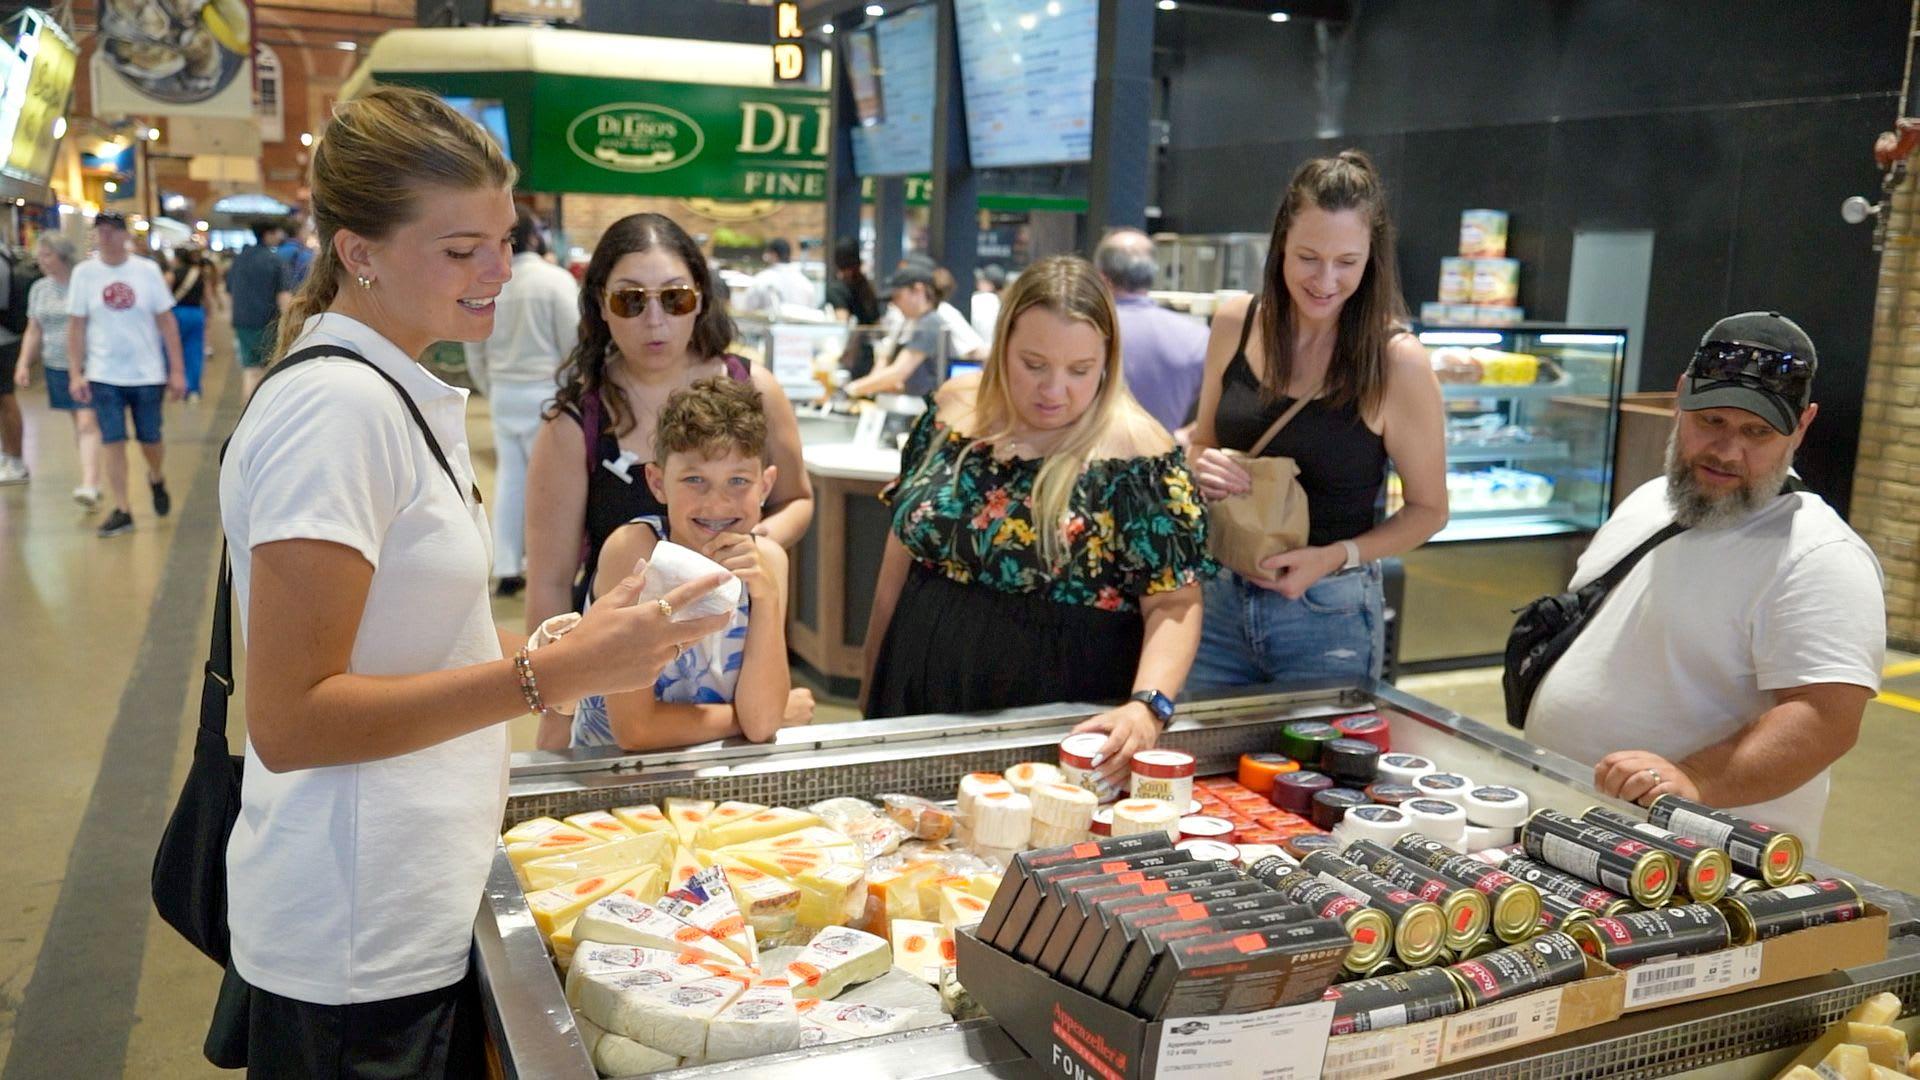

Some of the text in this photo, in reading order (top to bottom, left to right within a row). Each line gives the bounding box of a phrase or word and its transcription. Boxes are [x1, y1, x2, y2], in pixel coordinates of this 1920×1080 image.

[744, 171, 824, 196] FINE
[1291, 948, 1344, 964] FONDUE
[1052, 1043, 1095, 1080] FON
